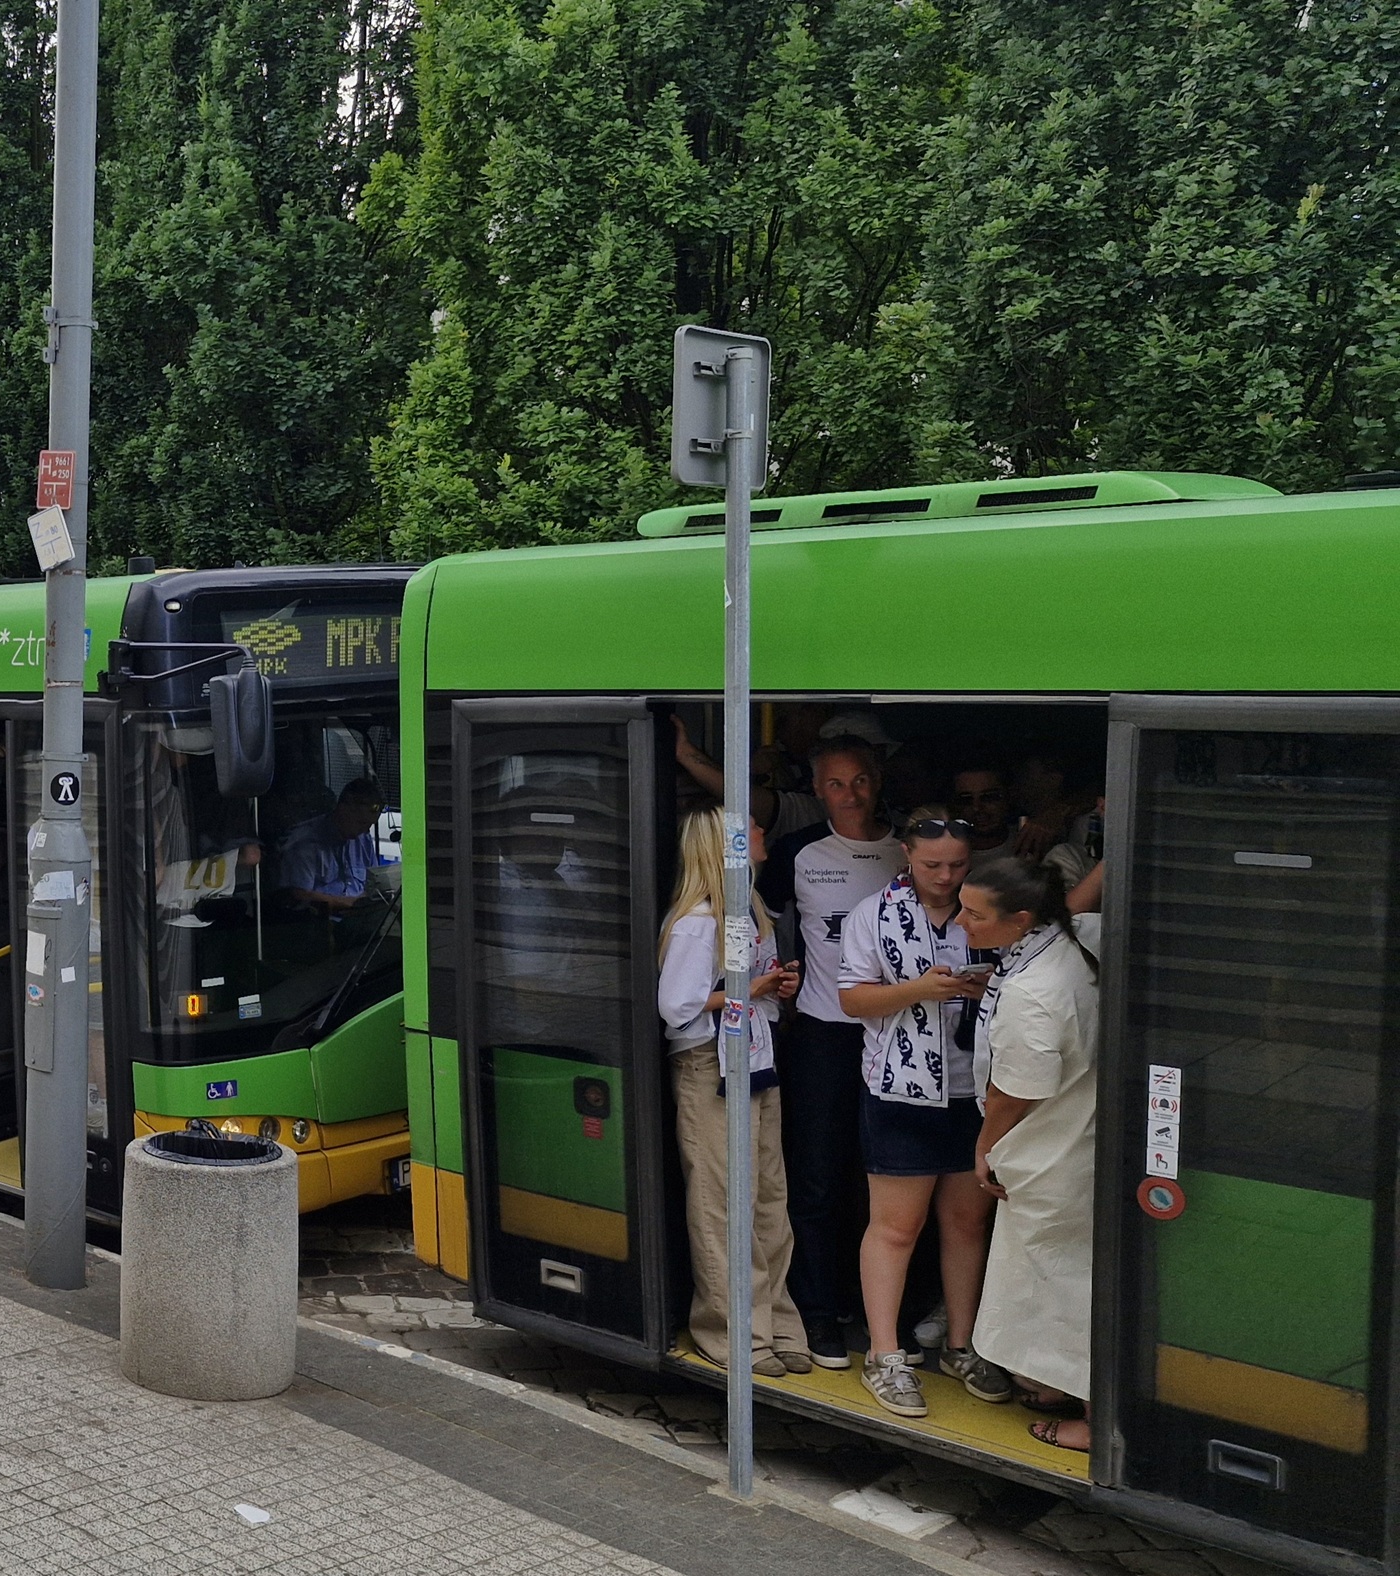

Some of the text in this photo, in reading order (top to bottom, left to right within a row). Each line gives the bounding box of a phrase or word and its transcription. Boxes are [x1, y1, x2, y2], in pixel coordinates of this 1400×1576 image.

[41, 458, 51, 475] H
[326, 617, 382, 667] MPK
[804, 868, 849, 877] Arbejdernes
